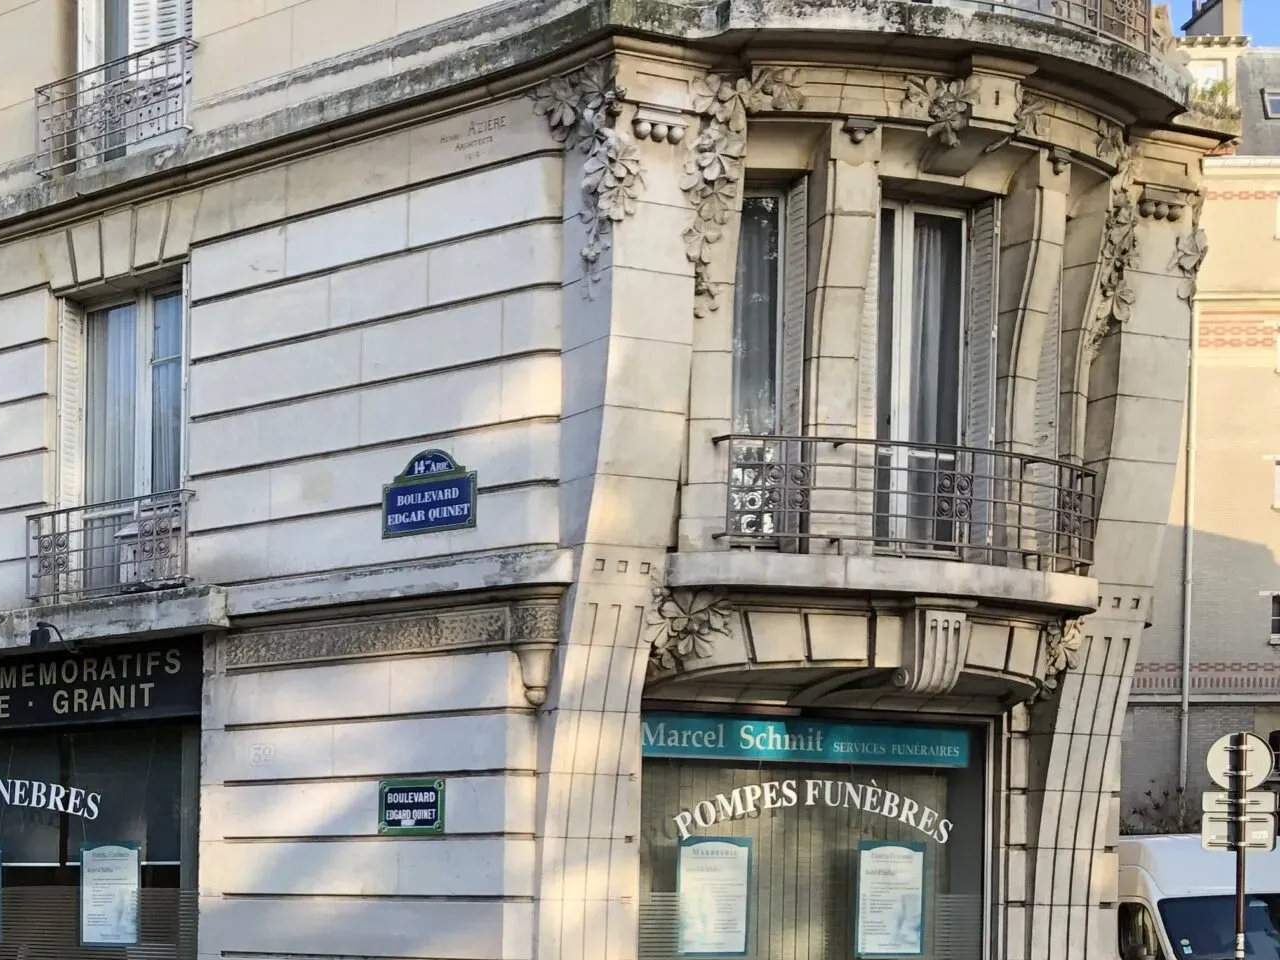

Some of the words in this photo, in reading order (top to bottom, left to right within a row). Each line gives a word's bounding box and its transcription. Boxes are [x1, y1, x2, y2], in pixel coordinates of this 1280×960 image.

[396, 487, 460, 507] BOULEVARD
[387, 509, 425, 526] EDGAR
[428, 503, 470, 522] QUINET
[52, 682, 155, 715] GRANIT
[640, 721, 726, 748] Marcel
[739, 724, 825, 753] Schmit
[832, 740, 886, 755] SERVICES
[891, 742, 960, 758] FUNÉRAIRES
[387, 791, 436, 804] BOULEVARD
[386, 809, 411, 820] EDGARD
[412, 808, 436, 821] QUINET
[672, 779, 799, 842] POMPES
[805, 779, 955, 845] FUNÈBRES
